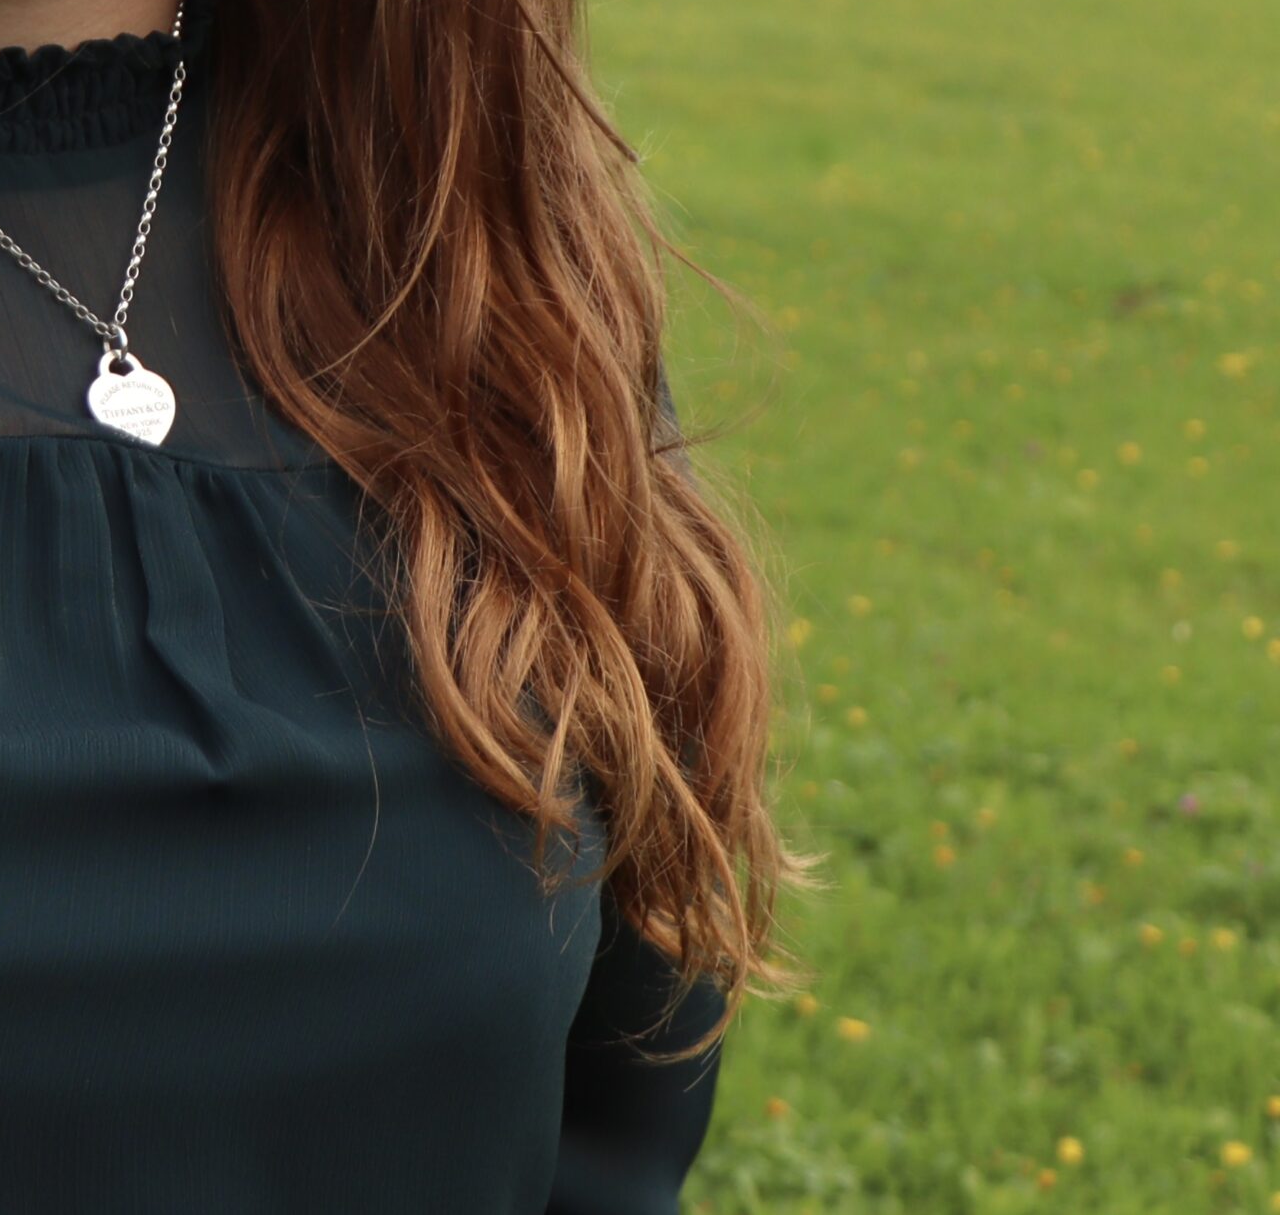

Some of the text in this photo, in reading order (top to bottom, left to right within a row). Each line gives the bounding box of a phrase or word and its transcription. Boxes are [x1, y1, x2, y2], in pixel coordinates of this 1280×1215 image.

[99, 381, 164, 406] PLEASE RETURN TO
